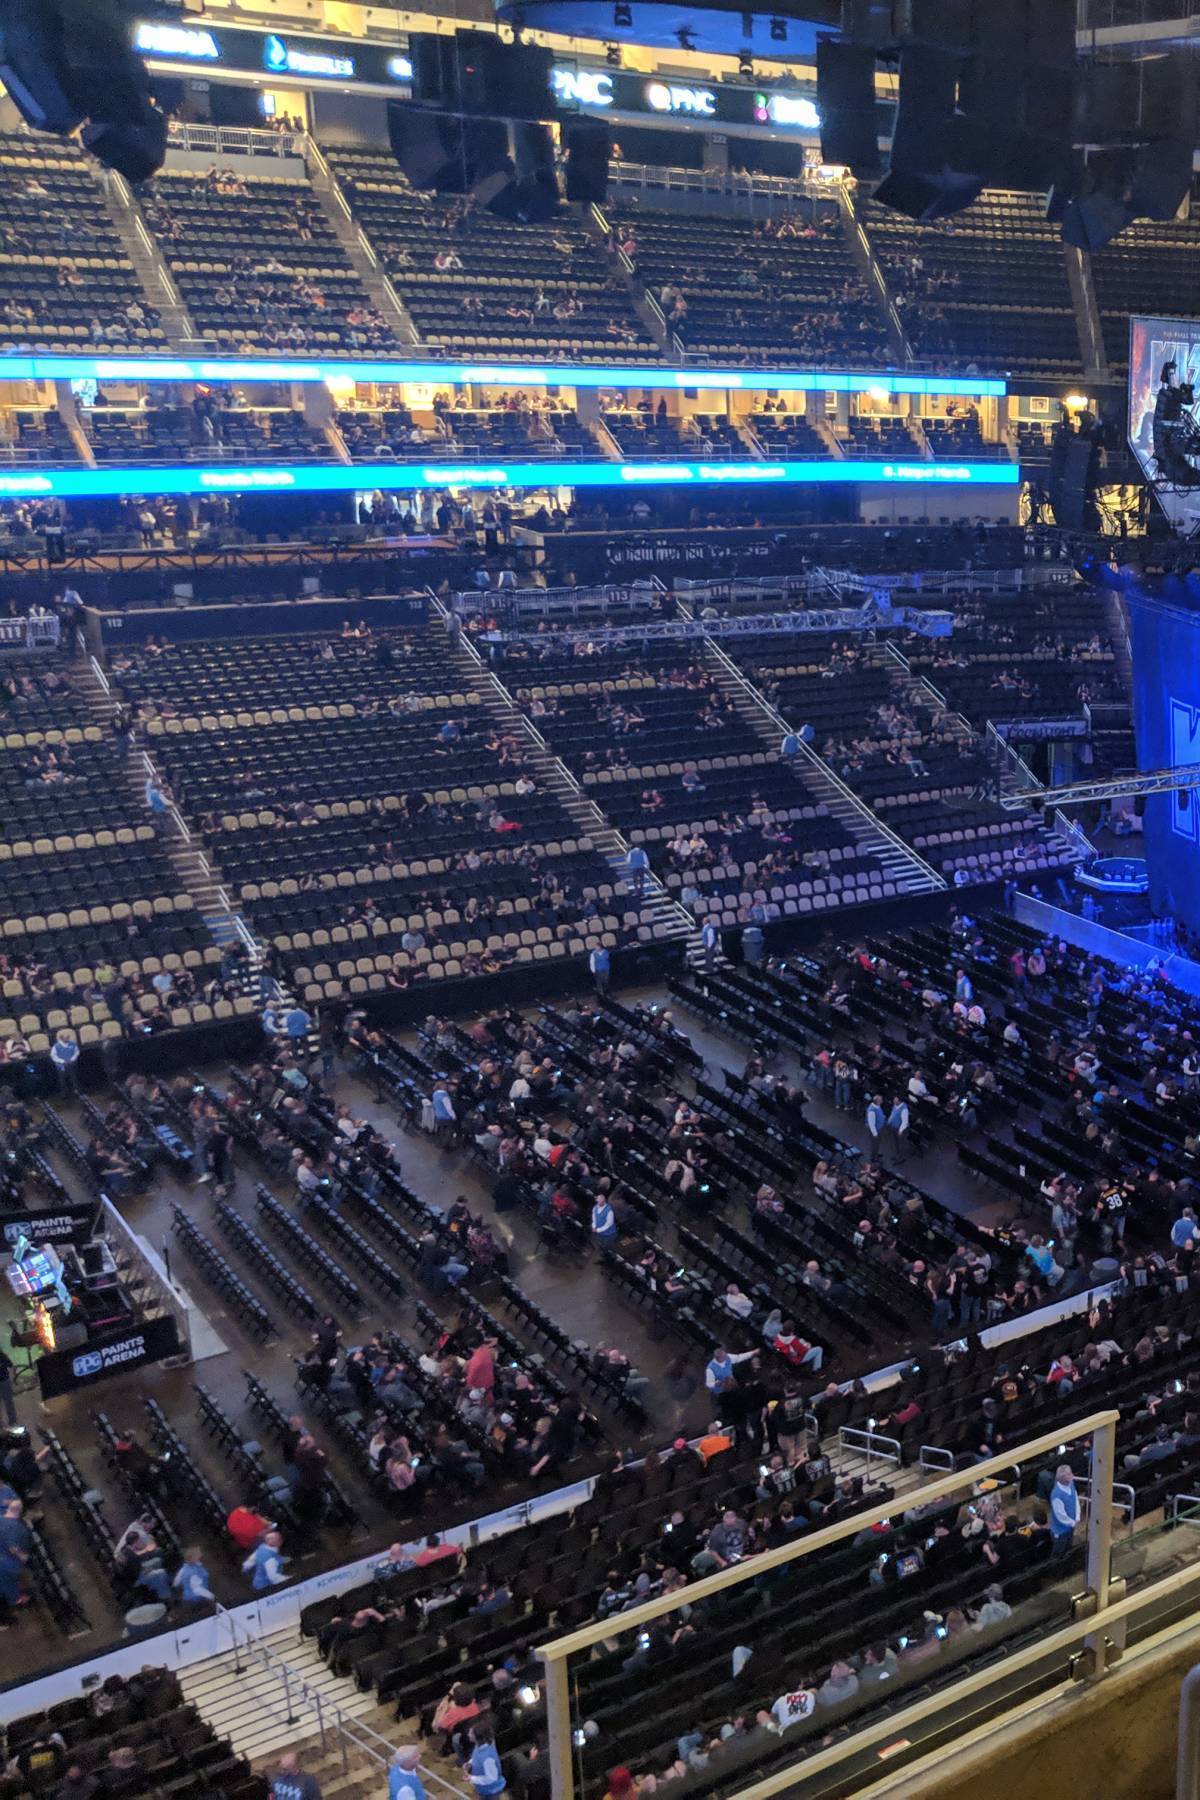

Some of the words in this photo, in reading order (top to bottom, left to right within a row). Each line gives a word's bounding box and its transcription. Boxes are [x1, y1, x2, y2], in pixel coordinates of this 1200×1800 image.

[609, 590, 629, 601] 113
[106, 618, 123, 628] 112
[1105, 1193, 1124, 1210] 38
[31, 1216, 73, 1229] PAINTS
[34, 1225, 73, 1238] ARENA
[101, 1336, 145, 1356] PAINTS
[73, 1351, 103, 1376] PPG
[104, 1346, 146, 1367] ARENA
